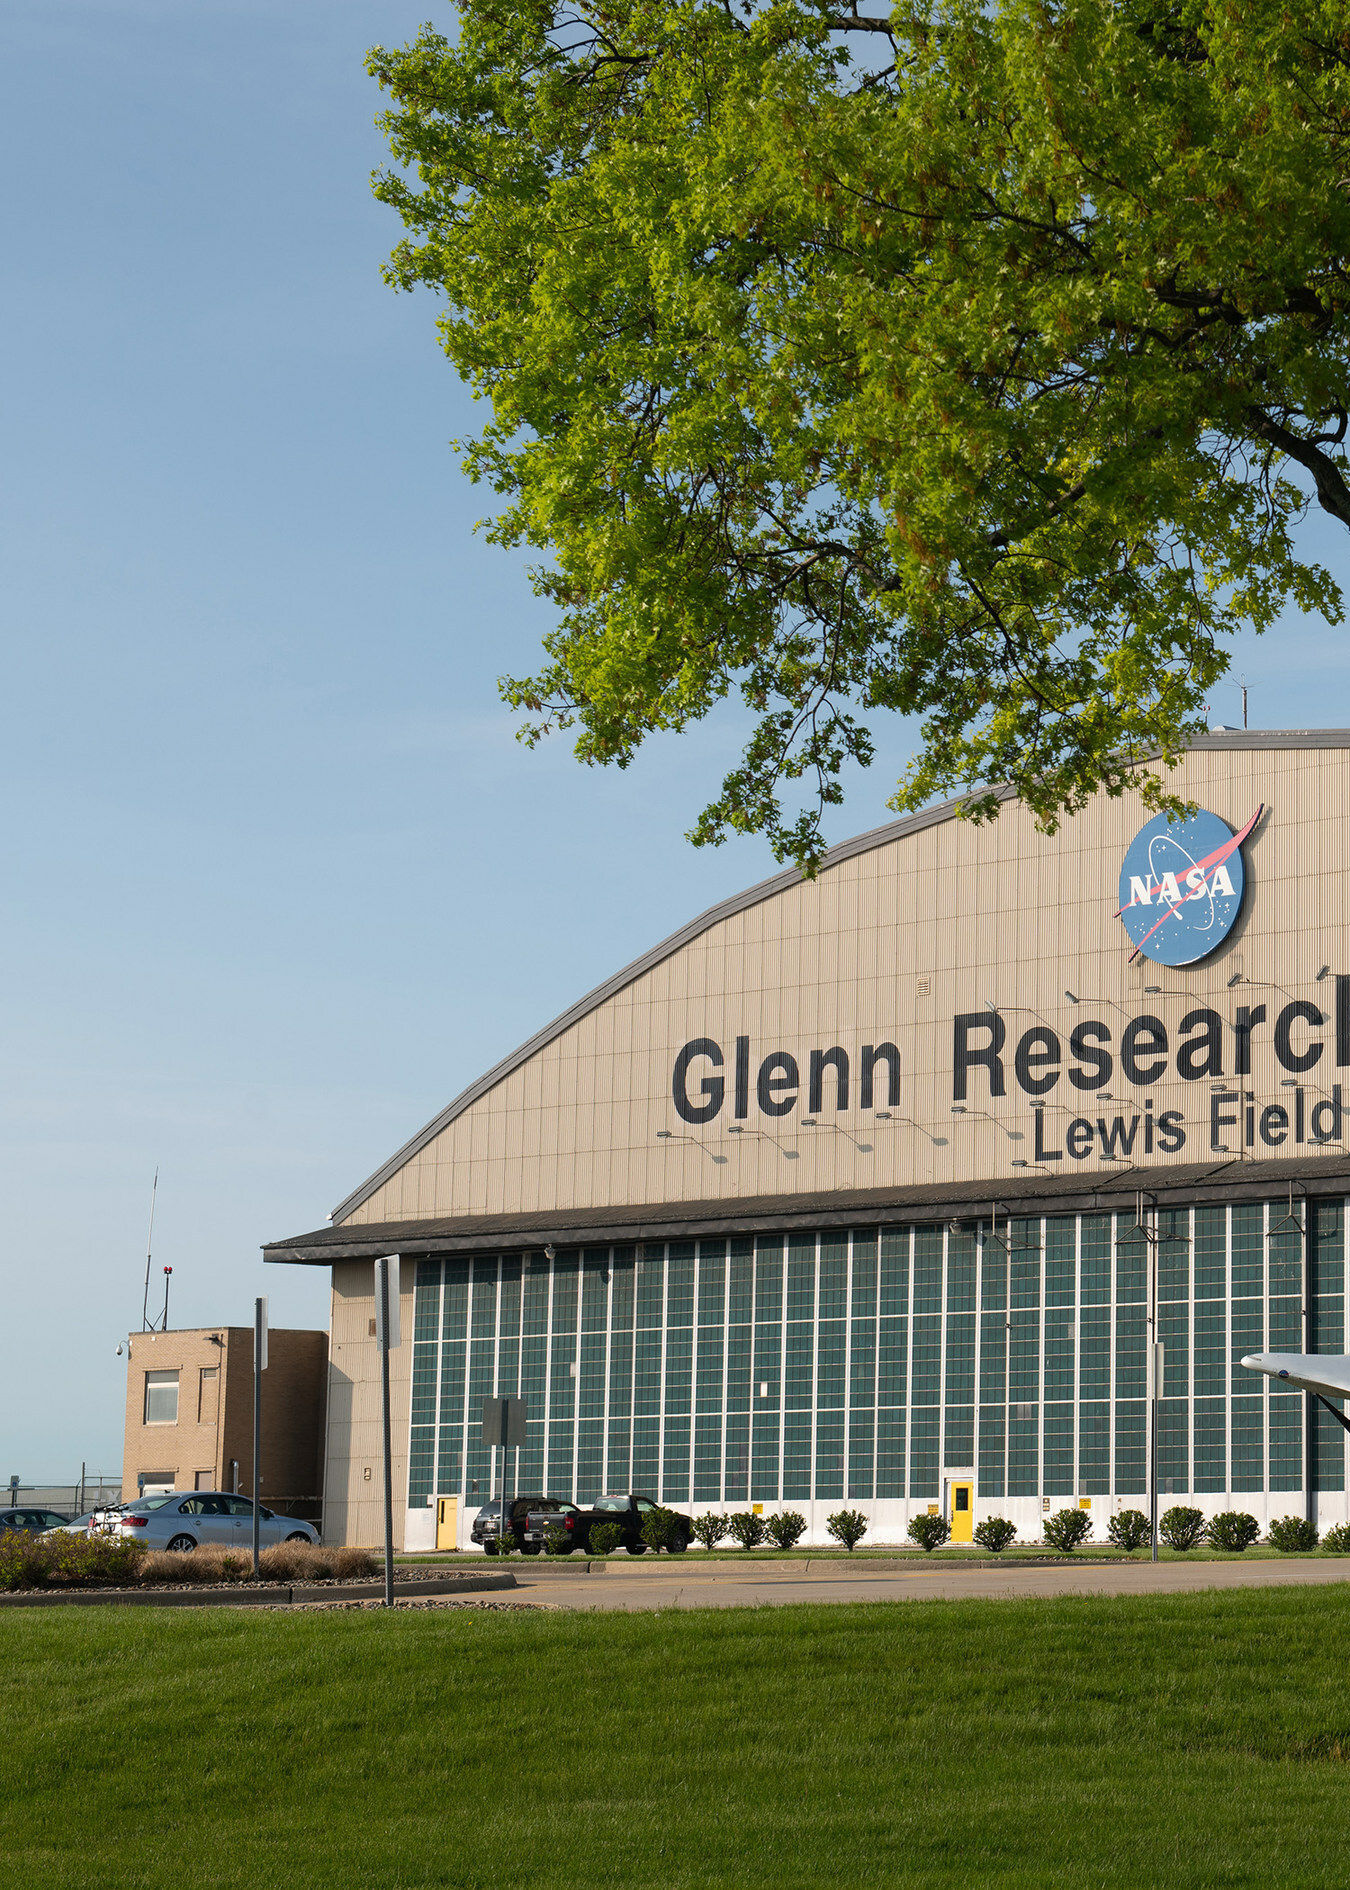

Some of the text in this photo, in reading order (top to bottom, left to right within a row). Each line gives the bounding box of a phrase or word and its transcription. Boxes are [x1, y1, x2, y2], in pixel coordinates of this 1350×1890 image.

[1129, 865, 1237, 907] NASA
[672, 1035, 900, 1125] Glenn
[1034, 1084, 1342, 1162] Lewis Field
